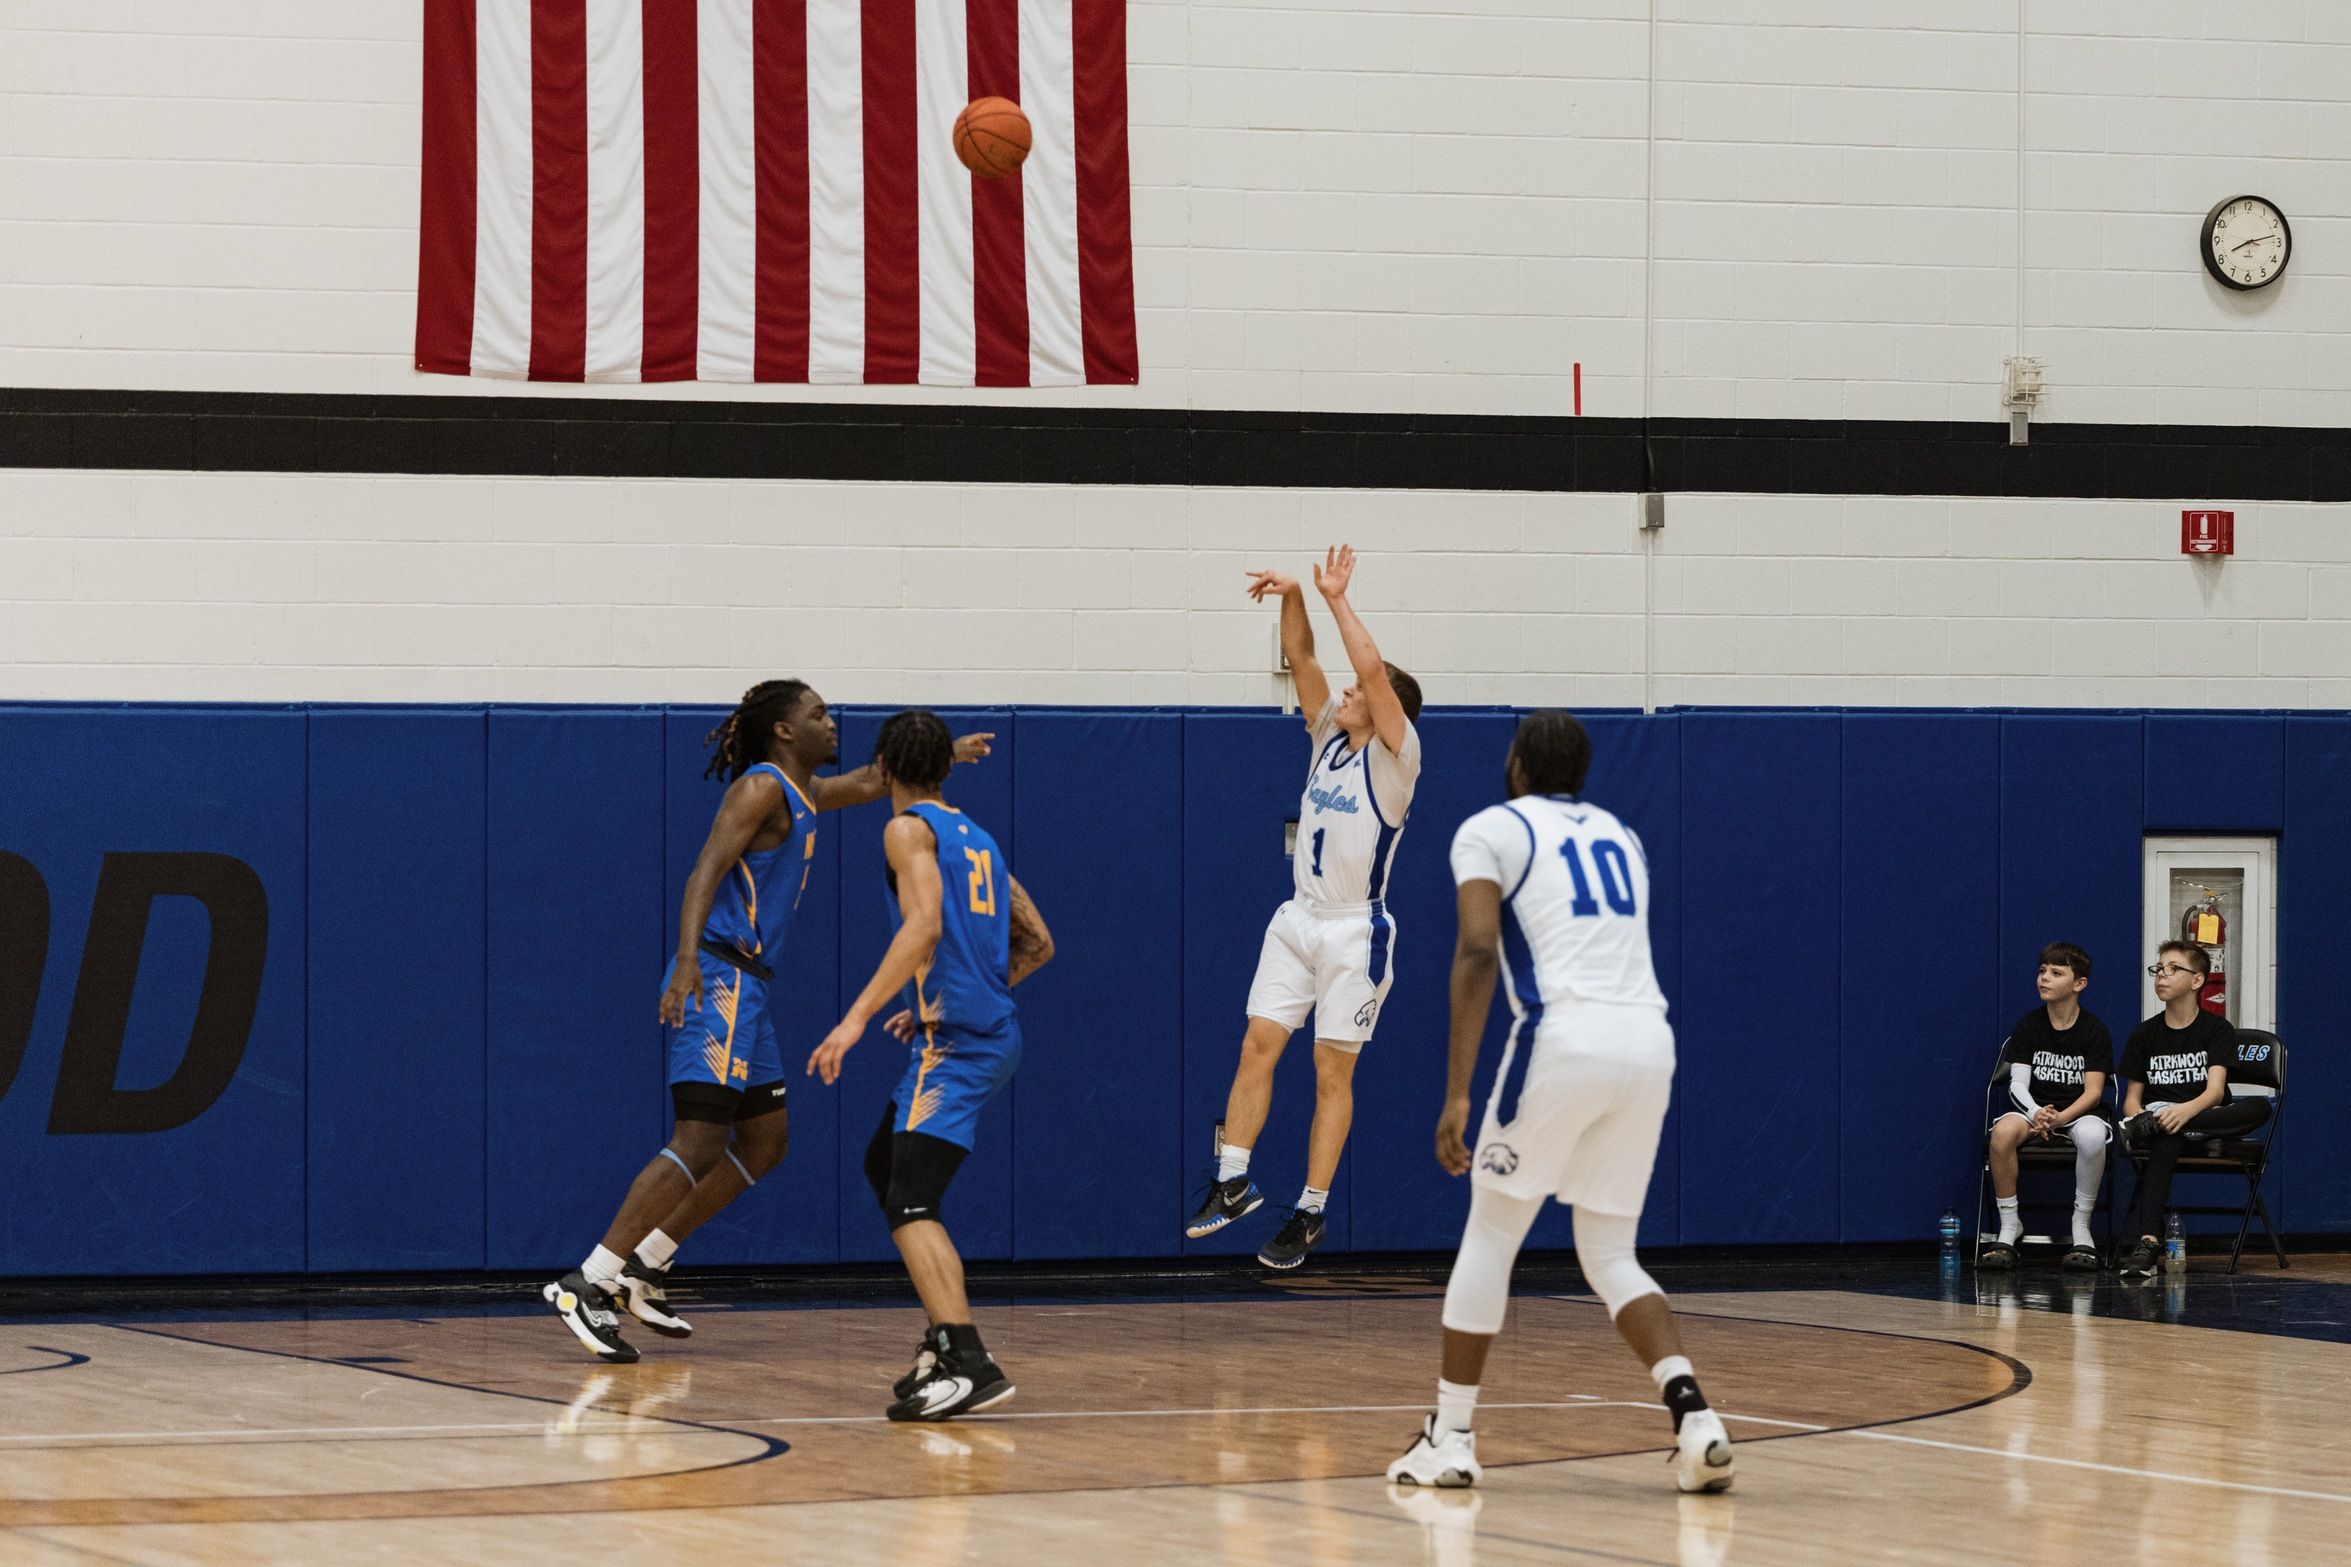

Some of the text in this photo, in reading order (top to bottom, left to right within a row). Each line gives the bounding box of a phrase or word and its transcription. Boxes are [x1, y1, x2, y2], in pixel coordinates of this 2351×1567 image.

[2229, 206, 2236, 216] 11
[2244, 201, 2253, 211] 12
[2272, 218, 2279, 229] 2
[2213, 235, 2221, 247] 9
[2276, 237, 2282, 248] 3
[2217, 253, 2225, 265] 8
[2270, 254, 2278, 264] 4
[2230, 267, 2236, 278] 7
[2244, 271, 2252, 283] 6
[2260, 267, 2267, 278] 5
[1311, 826, 1326, 878] 1
[963, 846, 996, 917] 21
[1558, 836, 1636, 917] 10
[0, 850, 269, 1135] D
[2146, 1066, 2208, 1085] BASKETBA
